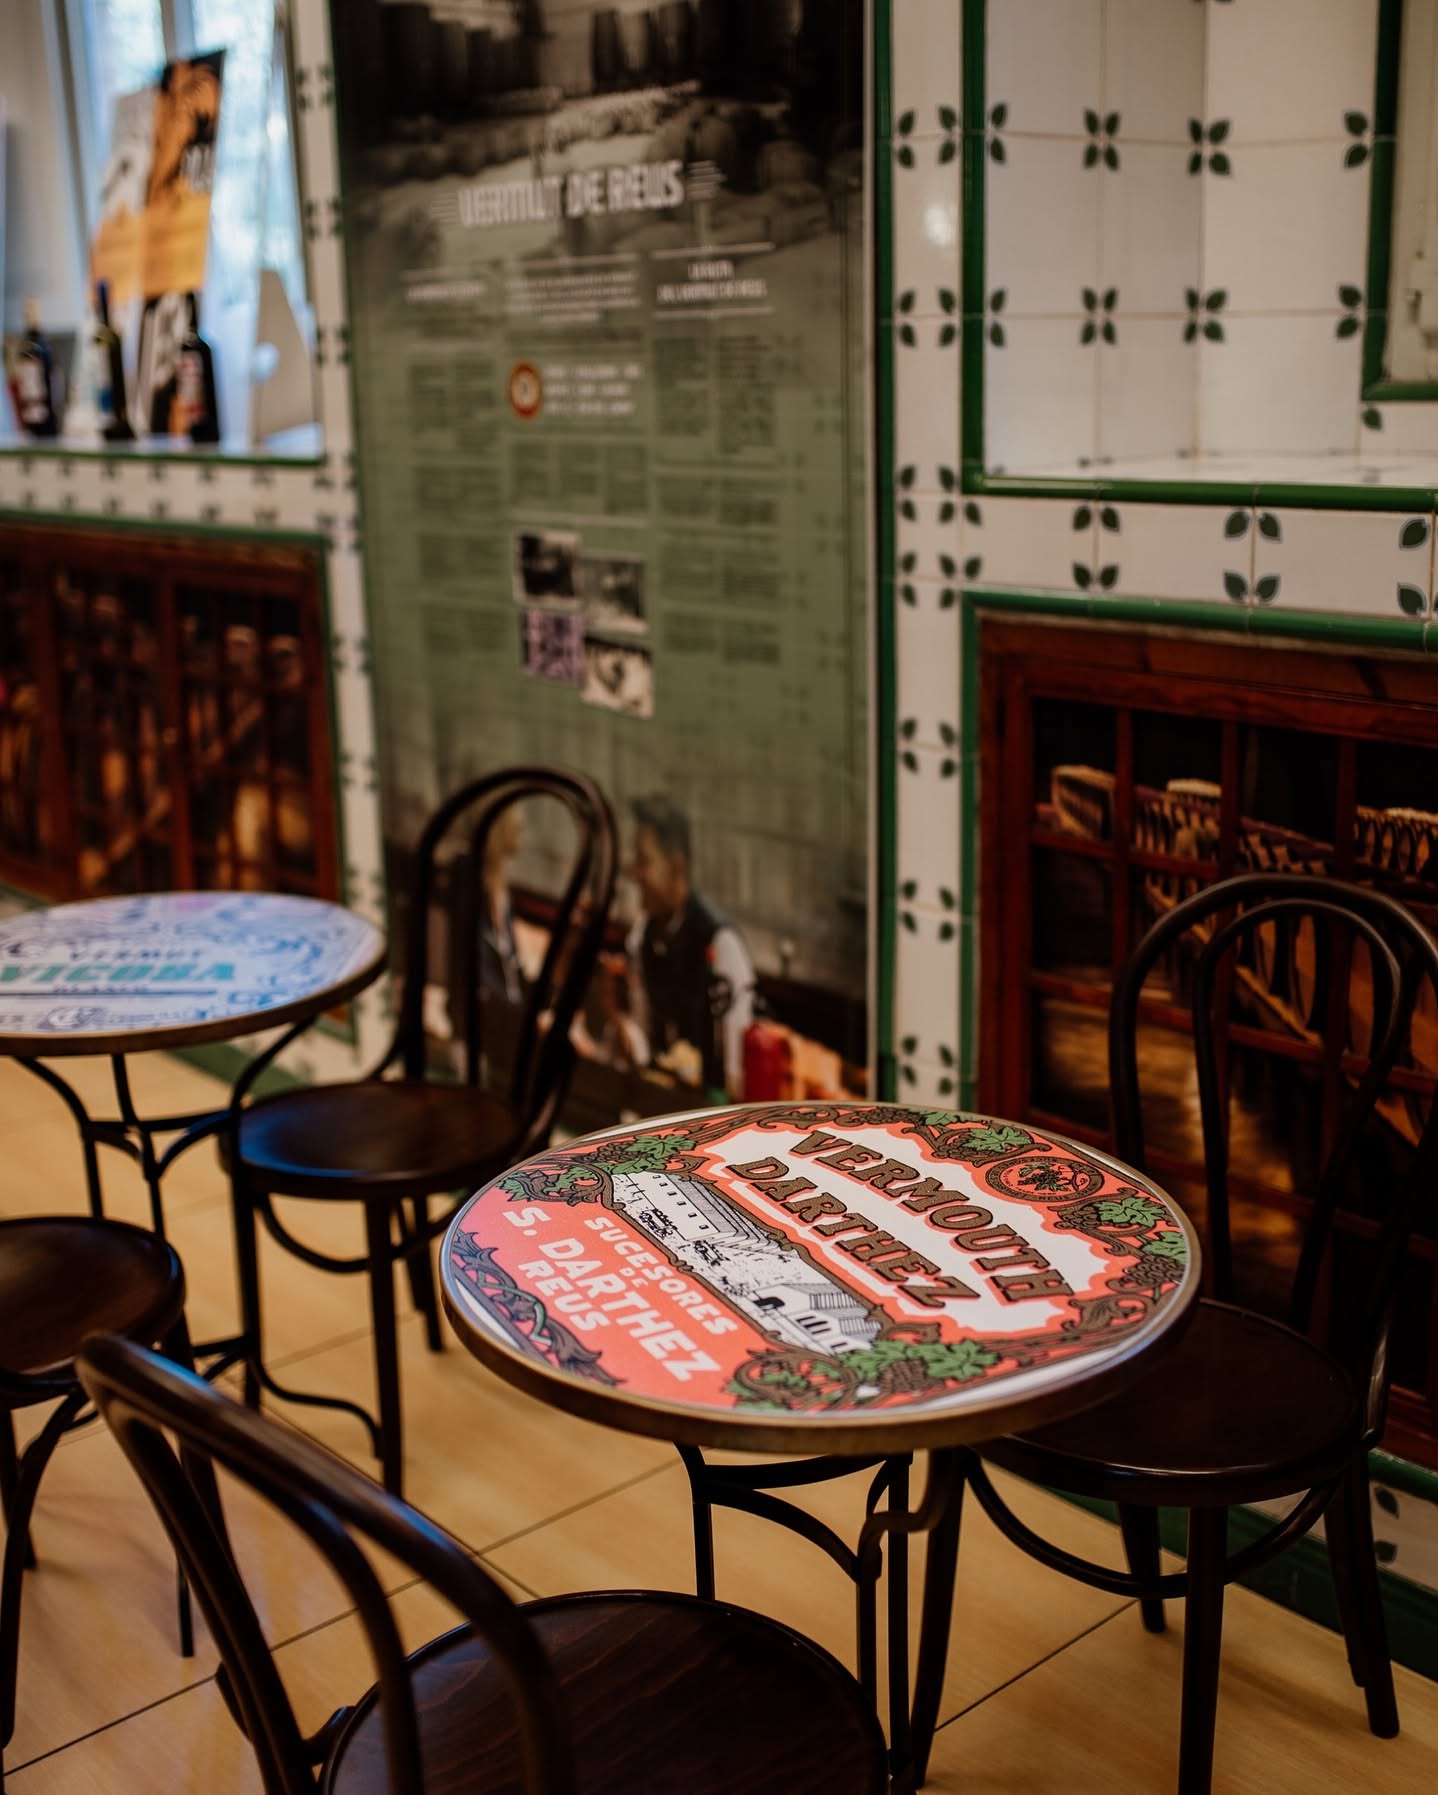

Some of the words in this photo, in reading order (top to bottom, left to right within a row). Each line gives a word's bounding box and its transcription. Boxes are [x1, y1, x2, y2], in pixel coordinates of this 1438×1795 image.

[565, 172, 606, 218] DE
[607, 160, 685, 212] REUS
[725, 1156, 981, 1308] DARTHEZ
[789, 1130, 1075, 1301] VERMOUTH
[502, 1206, 552, 1237] S.
[538, 1237, 723, 1382] DARTHEZ
[517, 1259, 612, 1332] REUS
[583, 1216, 739, 1335] SUCESORES
[619, 1266, 649, 1289] DE
